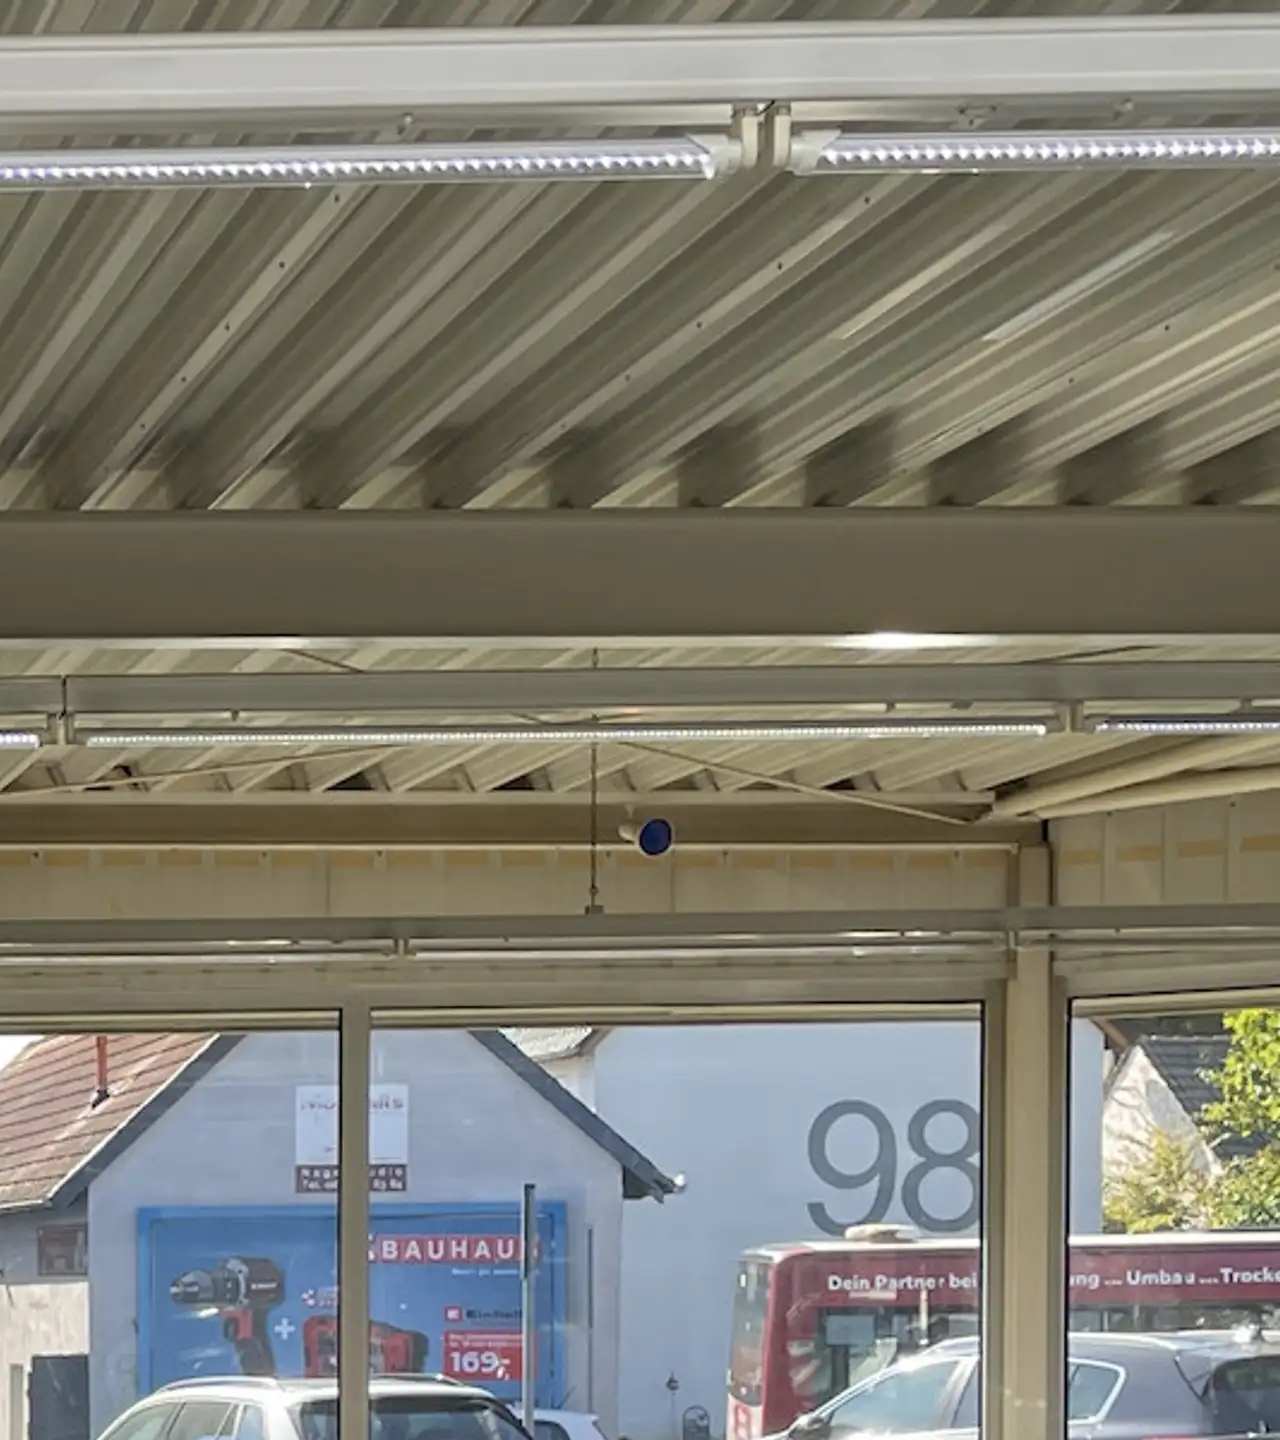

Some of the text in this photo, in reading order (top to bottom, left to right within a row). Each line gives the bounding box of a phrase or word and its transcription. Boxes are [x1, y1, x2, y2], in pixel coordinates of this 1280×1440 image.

[807, 1099, 981, 1237] 98
[382, 1238, 538, 1261] BAUHAU
[827, 1274, 870, 1291] Dein
[874, 1274, 944, 1291] Partner
[1126, 1269, 1195, 1286] Umbau
